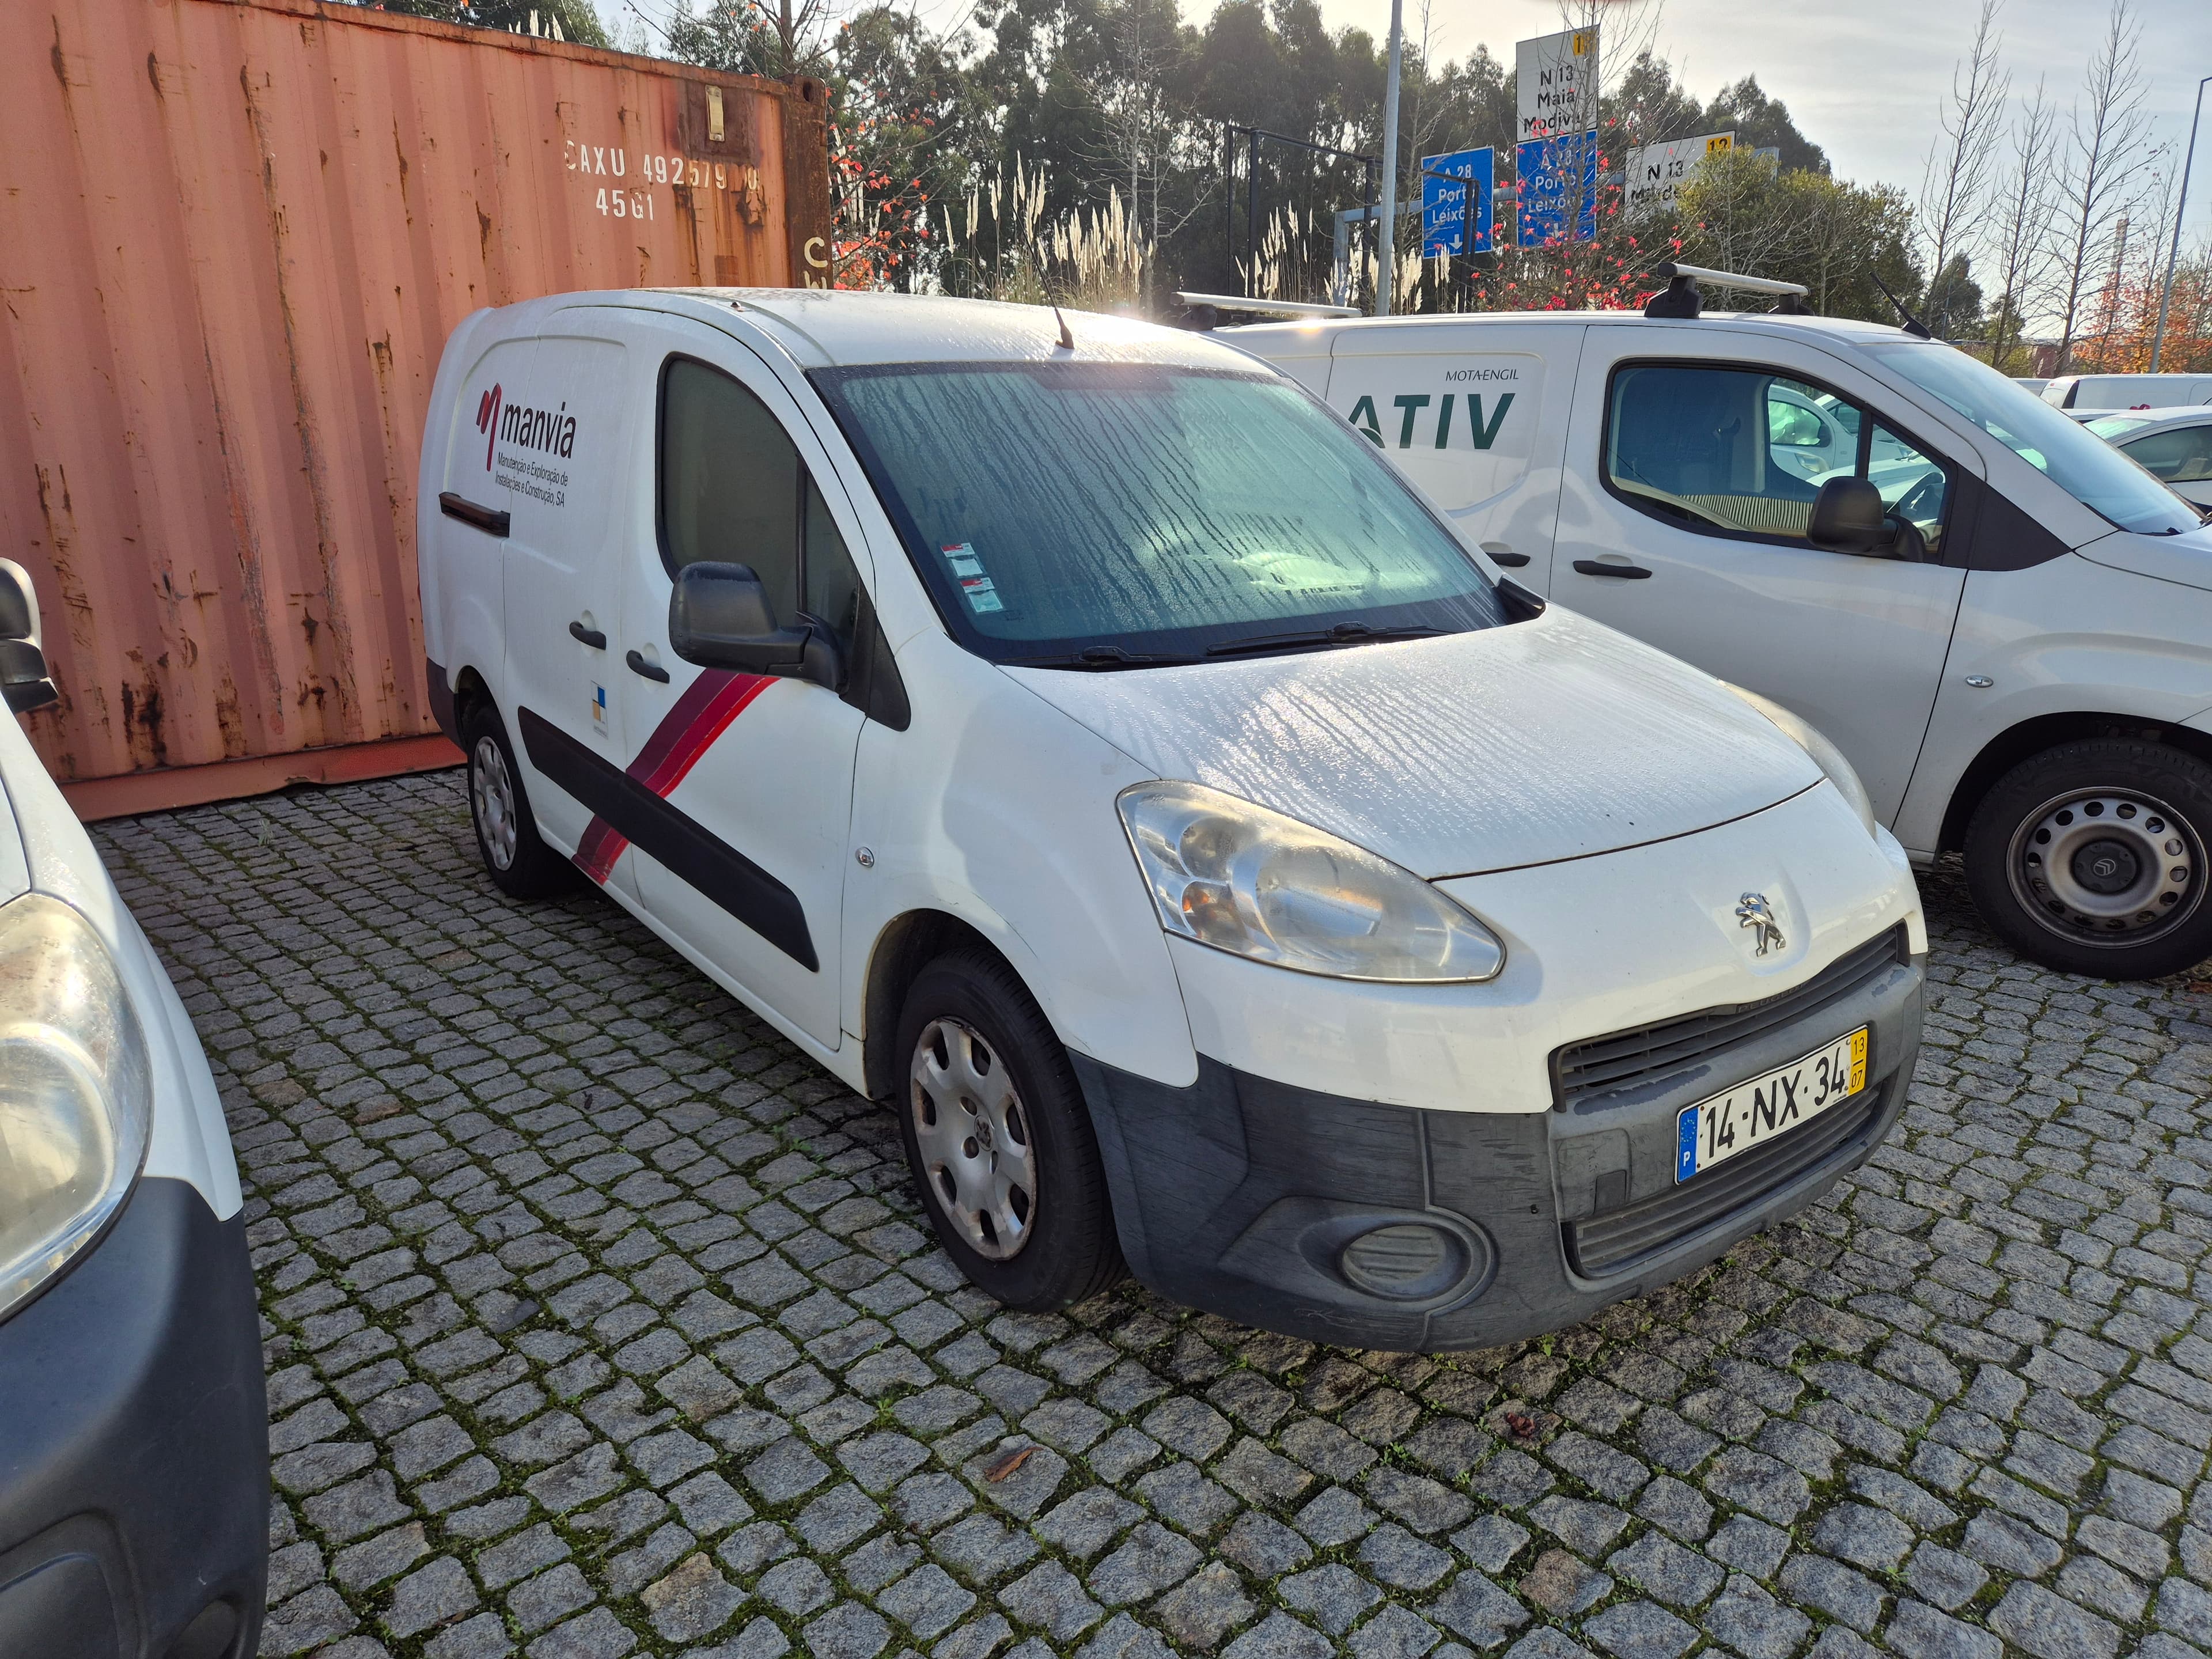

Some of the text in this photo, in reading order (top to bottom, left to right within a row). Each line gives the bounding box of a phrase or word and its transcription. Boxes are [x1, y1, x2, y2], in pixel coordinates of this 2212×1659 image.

[1540, 65, 1573, 86] N 13
[1537, 88, 1575, 108] Maia
[565, 140, 625, 176] CAXU
[1540, 153, 1551, 169] A
[1457, 164, 1472, 180] 28
[1647, 160, 1684, 181] N 13
[1438, 184, 1476, 203] Port
[596, 188, 654, 221] 45G1
[804, 236, 829, 268] C
[501, 402, 576, 459] manvia
[497, 452, 569, 487] Manutenção e Exploração de
[495, 470, 565, 507] Instalações e Construção, SA
[1854, 1036, 1865, 1056] 13
[1851, 1069, 1863, 1088] 07
[1683, 1151, 1690, 1166] P
